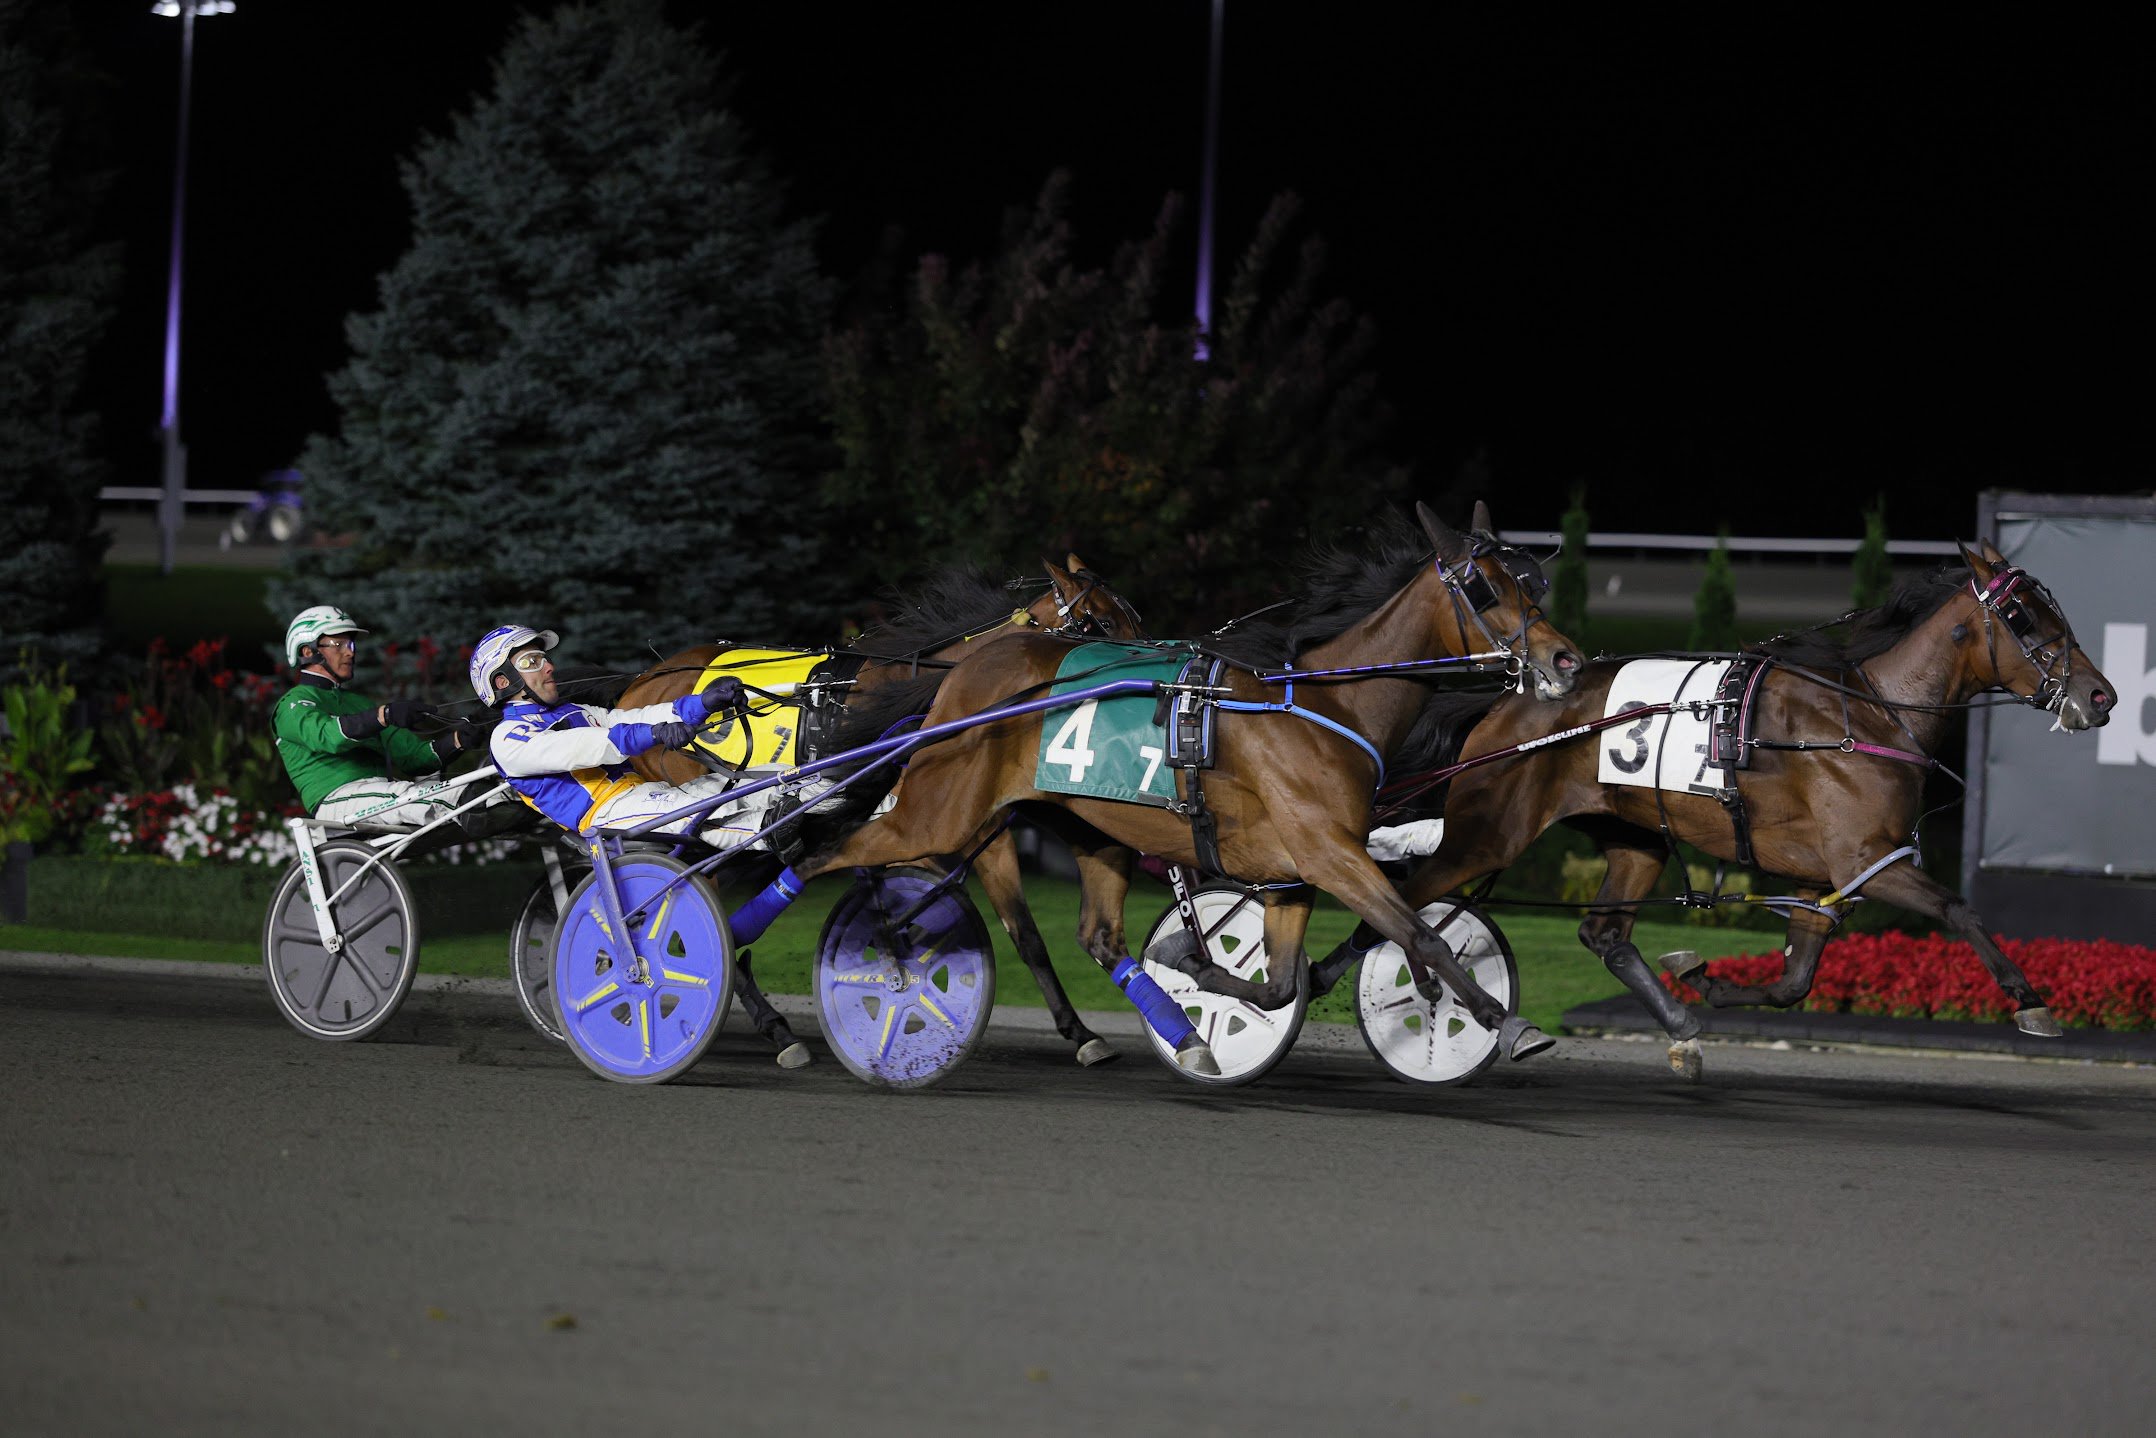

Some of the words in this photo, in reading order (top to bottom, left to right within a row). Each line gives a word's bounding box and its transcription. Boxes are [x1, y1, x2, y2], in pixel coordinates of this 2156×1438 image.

[770, 725, 792, 763] 7
[1045, 698, 1098, 783] 4
[1139, 745, 1164, 792] 7
[1608, 700, 1654, 775] 3
[1694, 744, 1709, 783] 7
[1167, 865, 1192, 918] UFO
